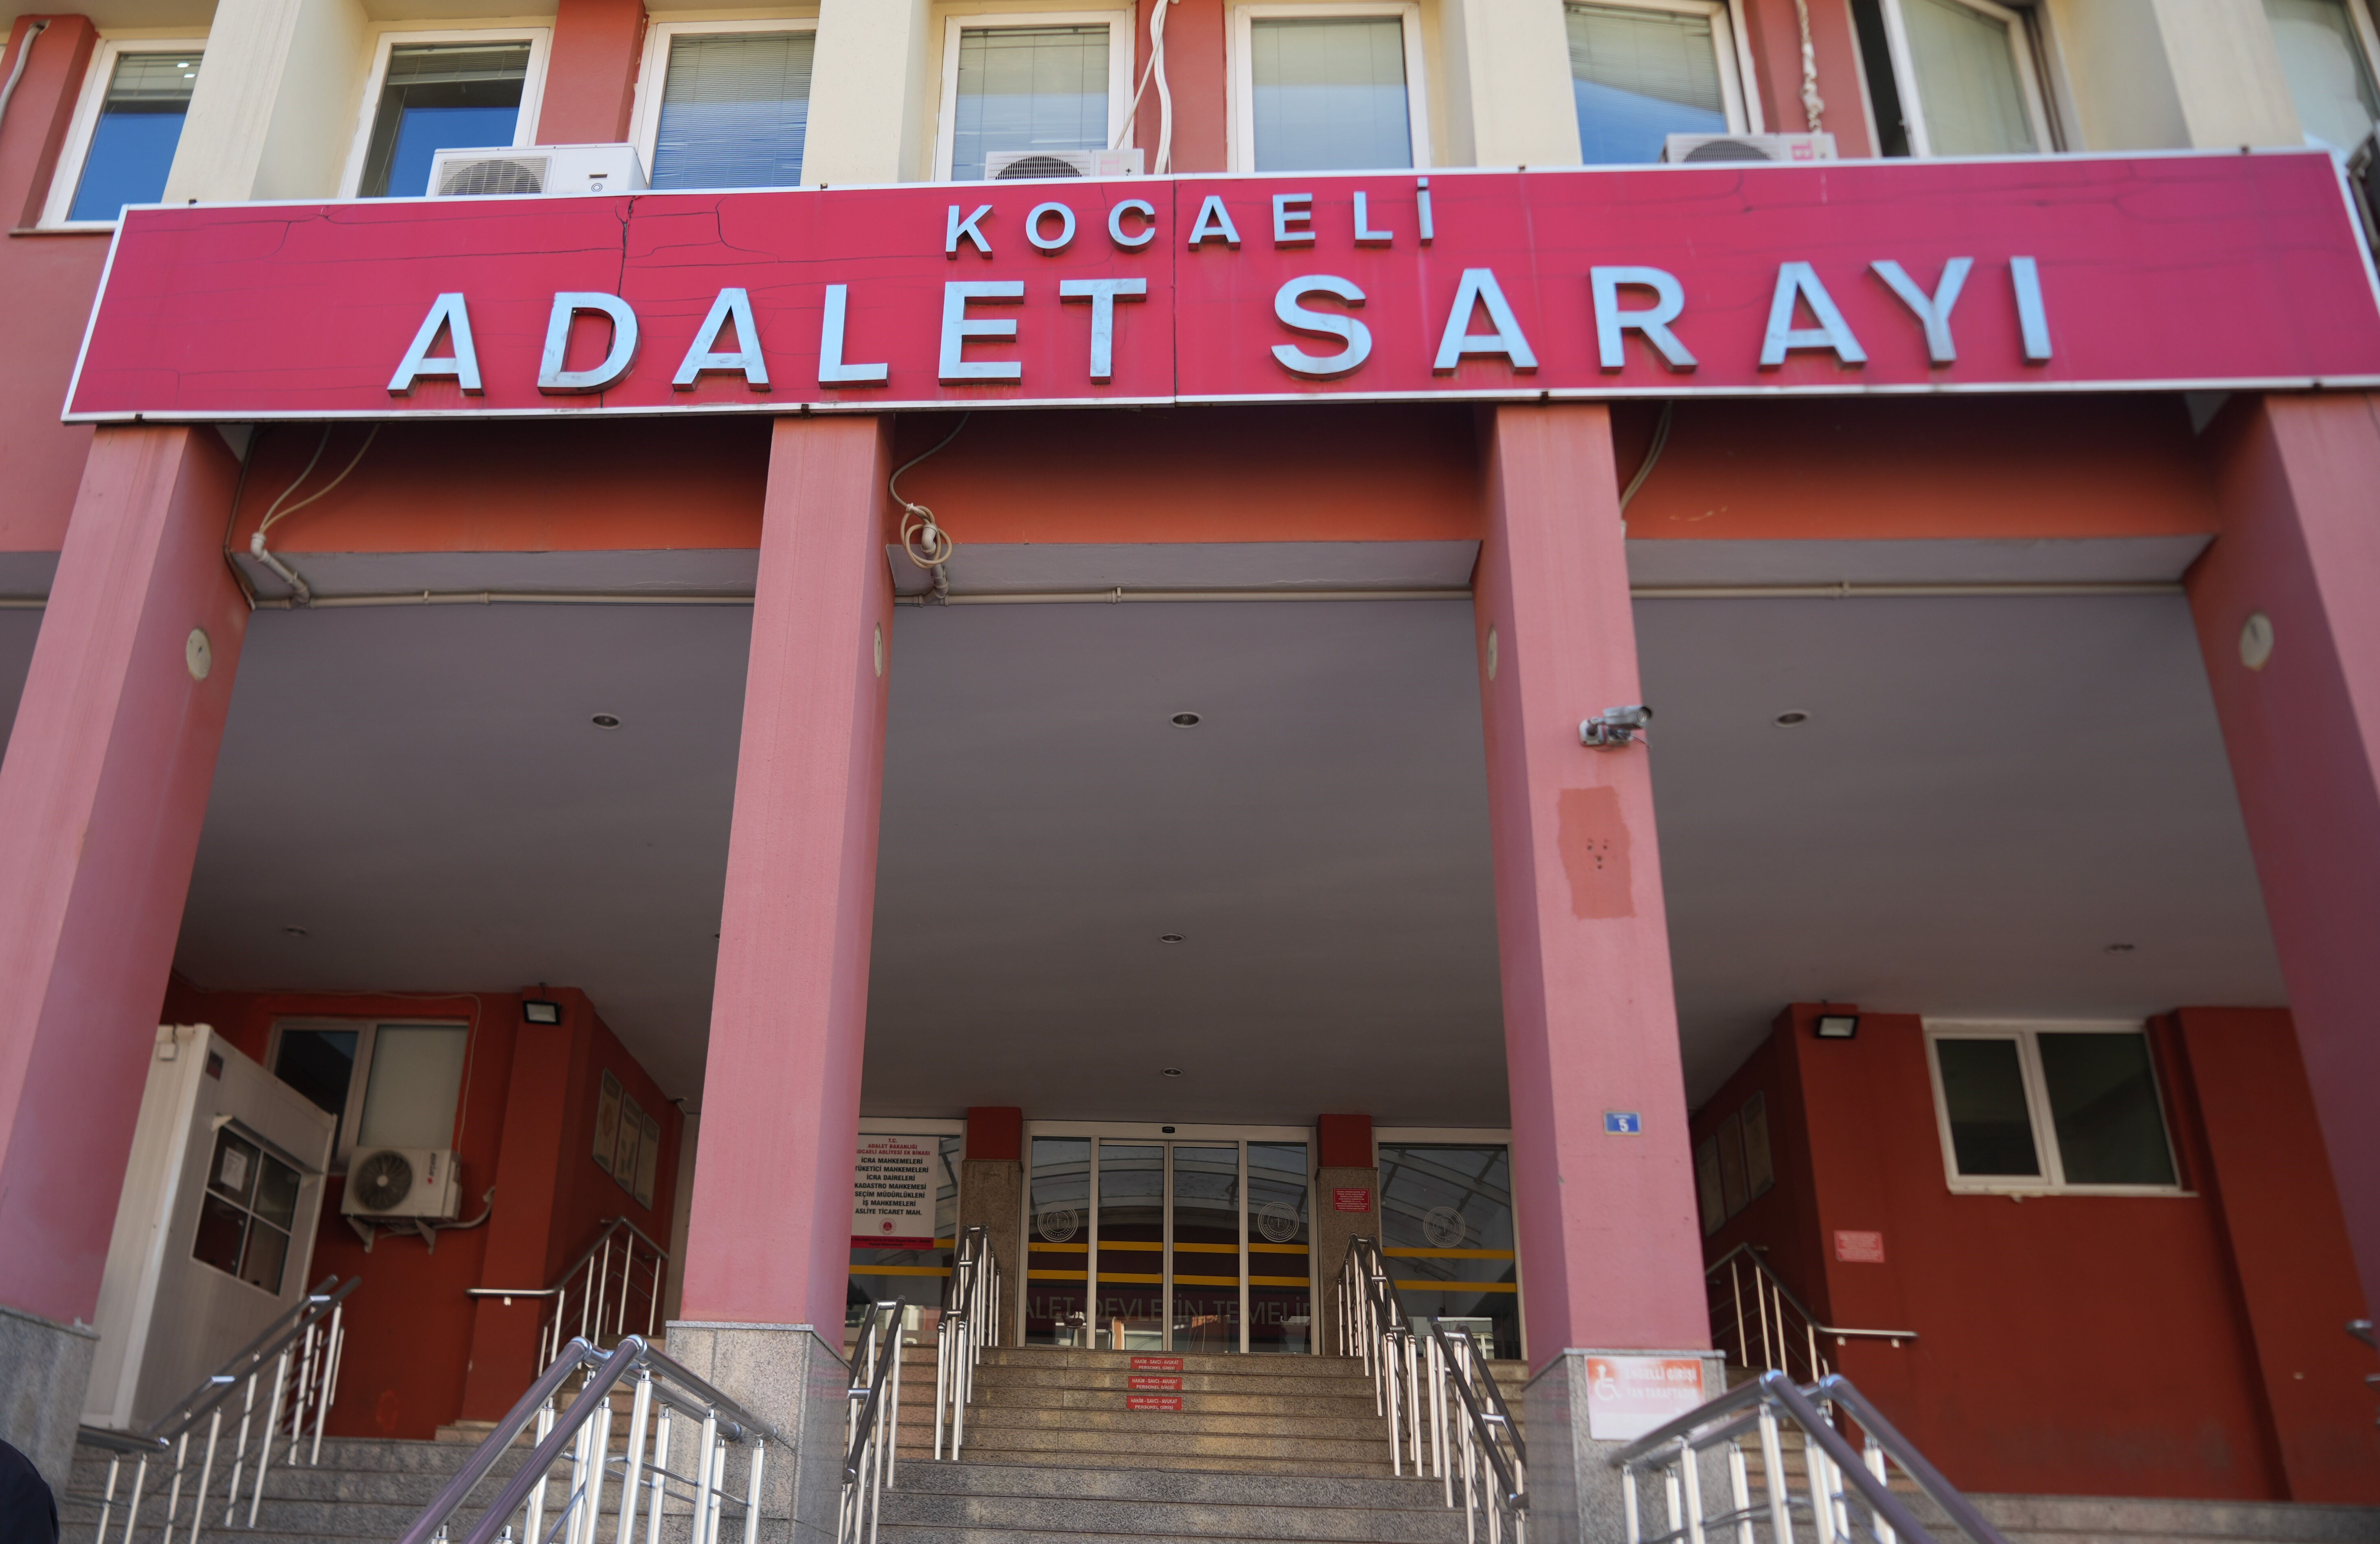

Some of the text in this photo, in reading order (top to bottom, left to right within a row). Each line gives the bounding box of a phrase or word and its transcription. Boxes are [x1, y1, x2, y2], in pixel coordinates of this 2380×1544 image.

[946, 177, 1436, 260] KOCAELİ
[387, 256, 2053, 398] ADALET SARAYI
[1618, 1119, 1629, 1132] 5
[1666, 1366, 1697, 1383] GİRİŞİ
